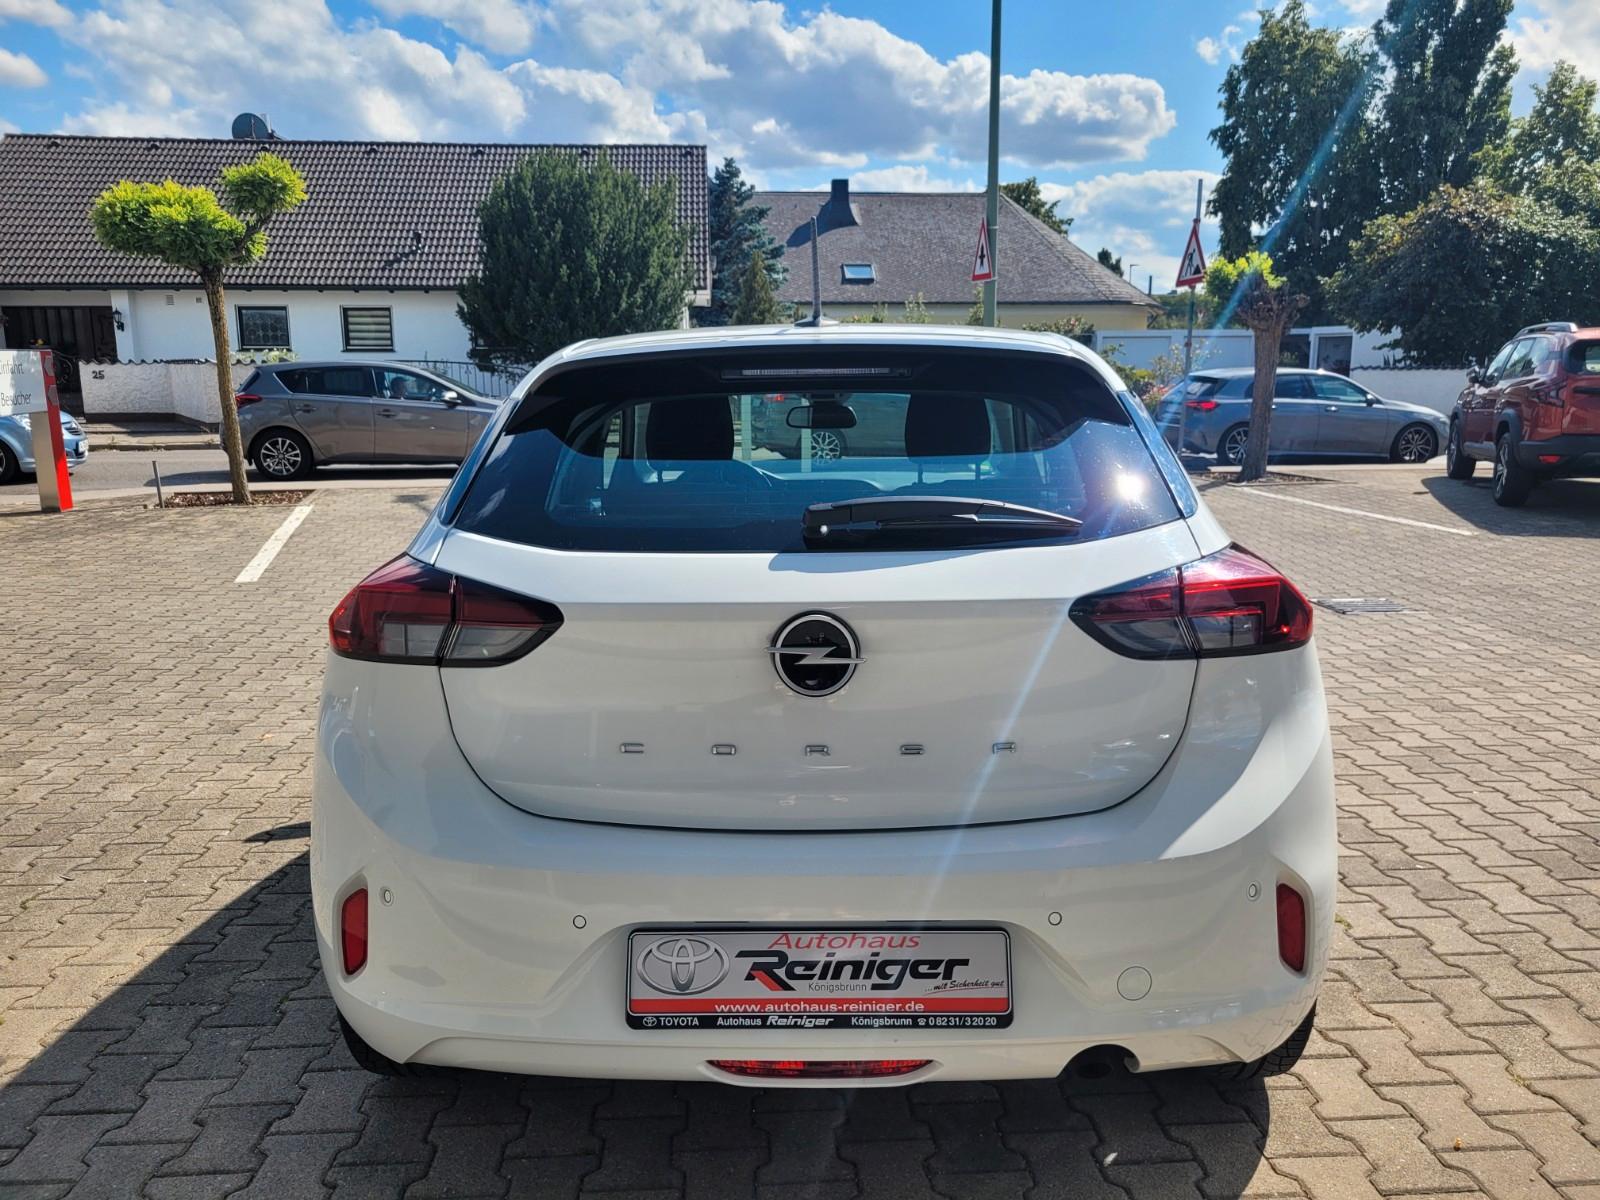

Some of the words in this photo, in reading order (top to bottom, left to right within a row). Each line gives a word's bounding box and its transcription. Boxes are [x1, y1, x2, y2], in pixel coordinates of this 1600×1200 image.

[0, 360, 24, 375] infahrt
[92, 370, 105, 380] 25
[1, 391, 31, 407] Besucher
[768, 933, 921, 949] Autohaus
[735, 950, 970, 991] Reiniger
[808, 982, 867, 993] Königsbrunn
[949, 978, 989, 989] Sicherheit
[990, 979, 1005, 989] gut
[715, 1001, 925, 1013] www.autohaus-reiniger.de
[659, 1016, 699, 1026] TOYOTA
[716, 1016, 762, 1026] Autohaus
[766, 1015, 834, 1028] Reiniger
[851, 1016, 913, 1027] Königsbrunn
